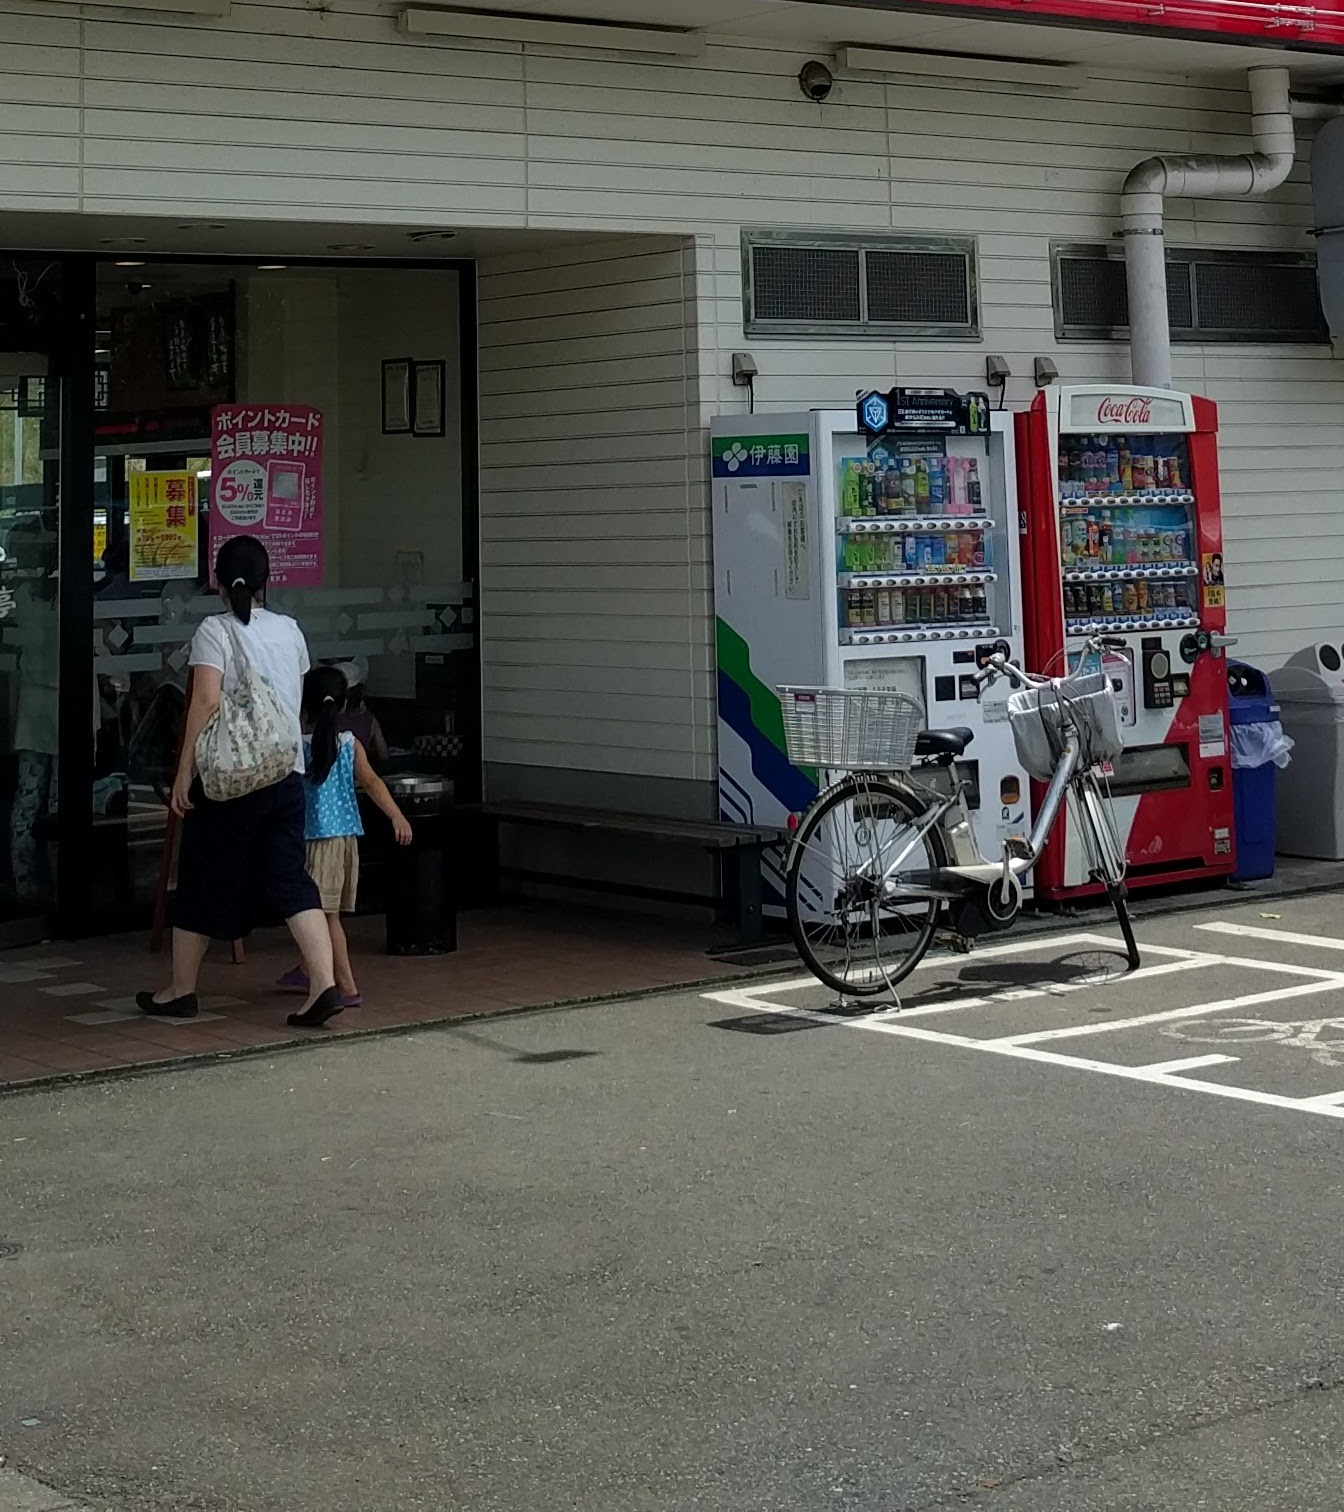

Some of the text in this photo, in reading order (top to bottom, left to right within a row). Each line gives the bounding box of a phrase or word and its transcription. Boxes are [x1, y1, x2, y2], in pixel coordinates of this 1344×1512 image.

[216, 408, 321, 431] ポイントカード
[1097, 397, 1153, 424] Coca-Cola
[749, 443, 799, 465] 伊藤園
[166, 478, 186, 528] 募集
